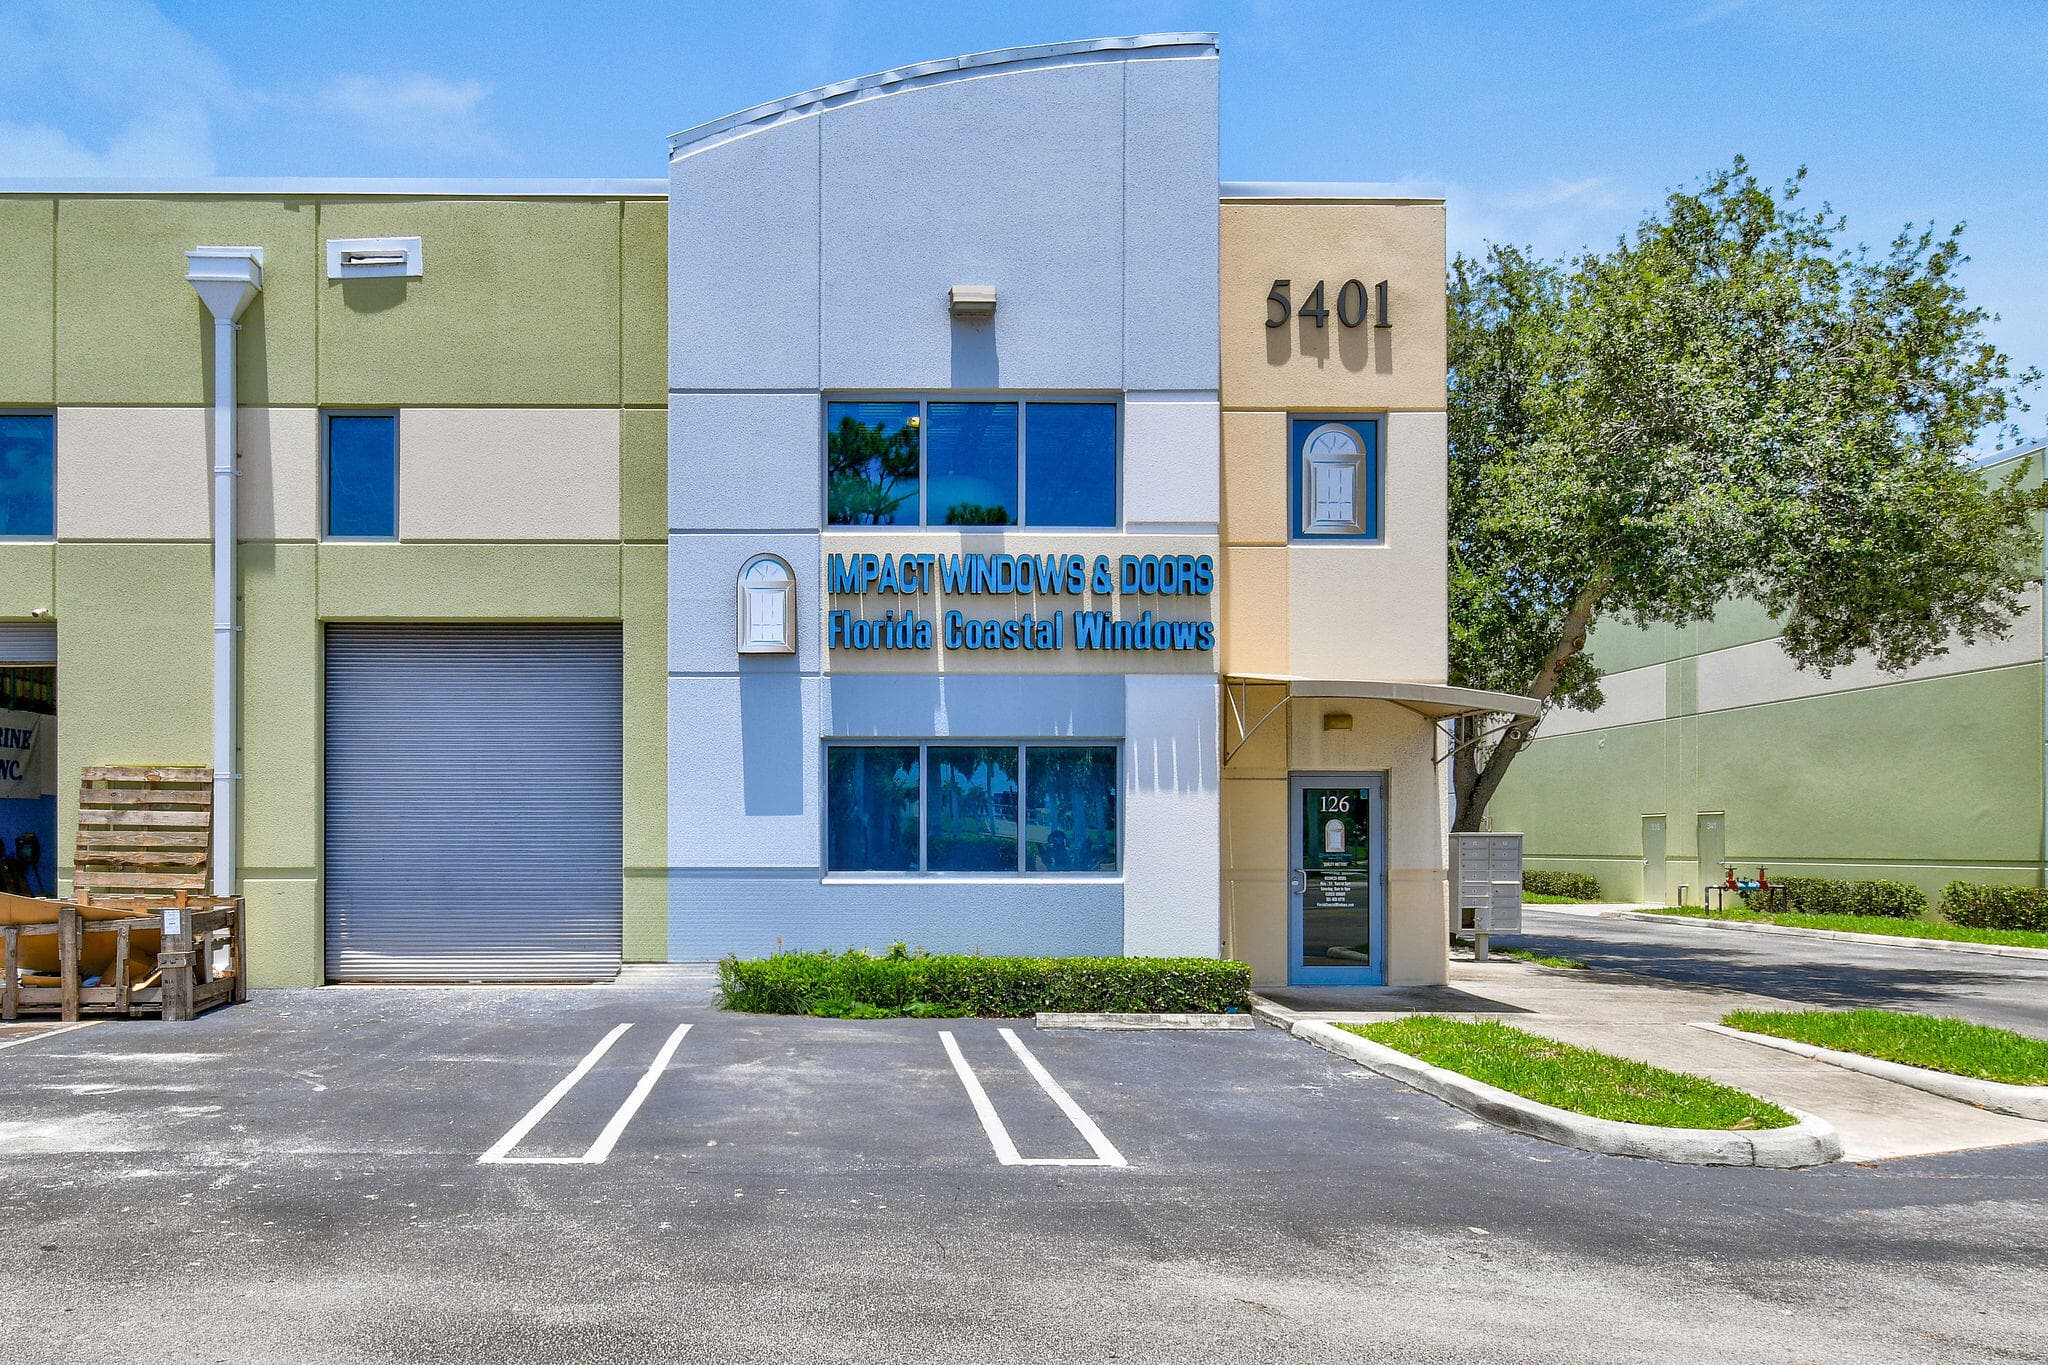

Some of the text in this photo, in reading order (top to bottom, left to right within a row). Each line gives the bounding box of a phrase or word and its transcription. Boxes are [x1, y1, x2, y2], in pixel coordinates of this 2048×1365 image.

[1265, 278, 1393, 328] 5401
[828, 553, 1214, 595] IMPACT WINDOWS & DOORS
[828, 609, 1216, 651] Florida Coastal Windows
[0, 727, 32, 750] INE
[1320, 795, 1350, 813] 126
